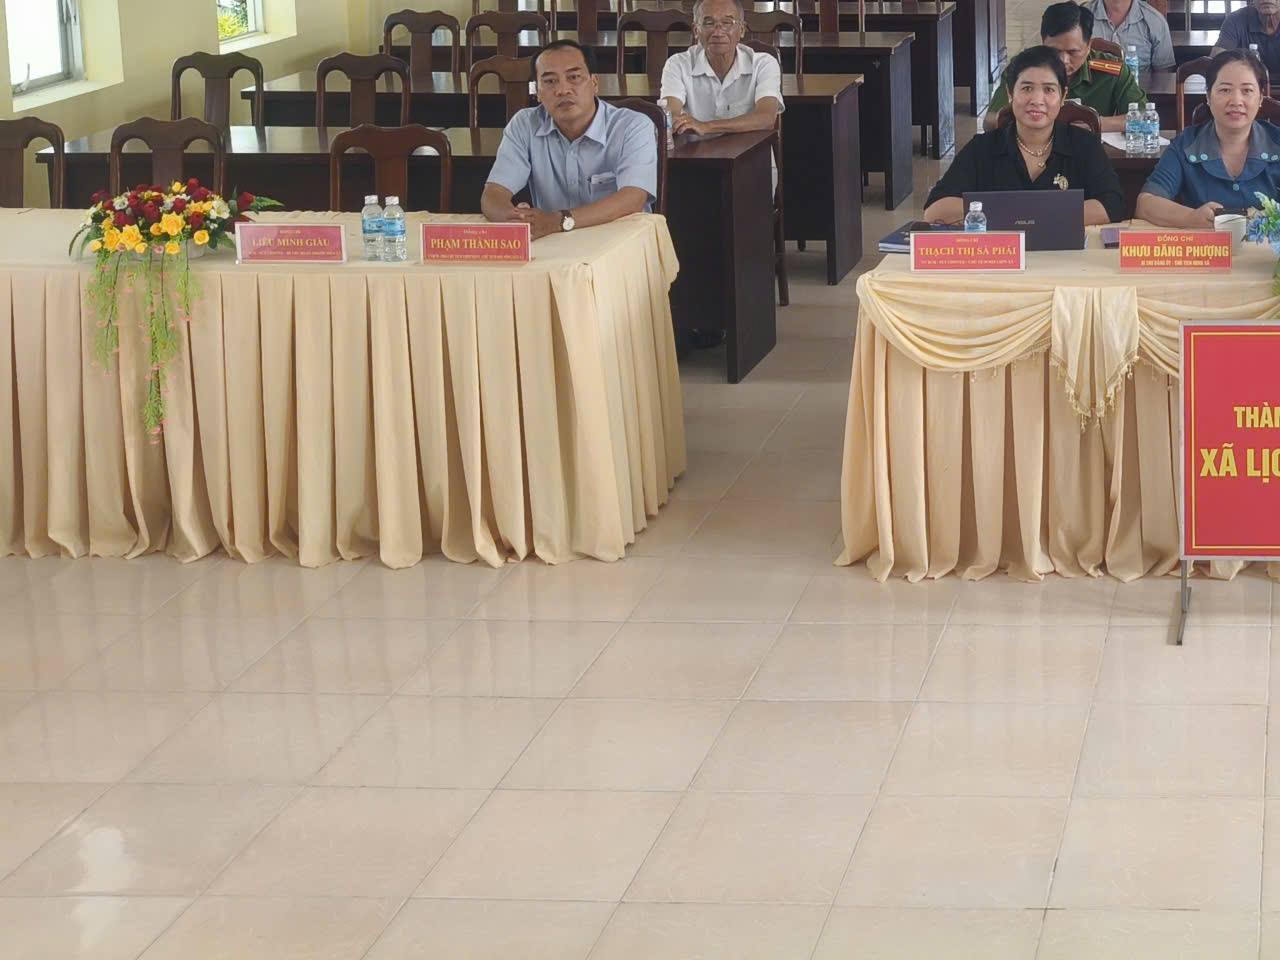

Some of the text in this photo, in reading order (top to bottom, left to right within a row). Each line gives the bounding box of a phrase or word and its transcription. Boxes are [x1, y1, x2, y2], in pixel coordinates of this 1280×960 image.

[277, 238, 304, 247] MINH
[431, 238, 460, 251] PHẠM
[500, 239, 521, 249] SAO
[918, 247, 954, 257] THẠCH
[956, 247, 975, 257] THỊ
[1185, 244, 1229, 260] PHƯỢNG
[1199, 442, 1238, 477] XÃ
